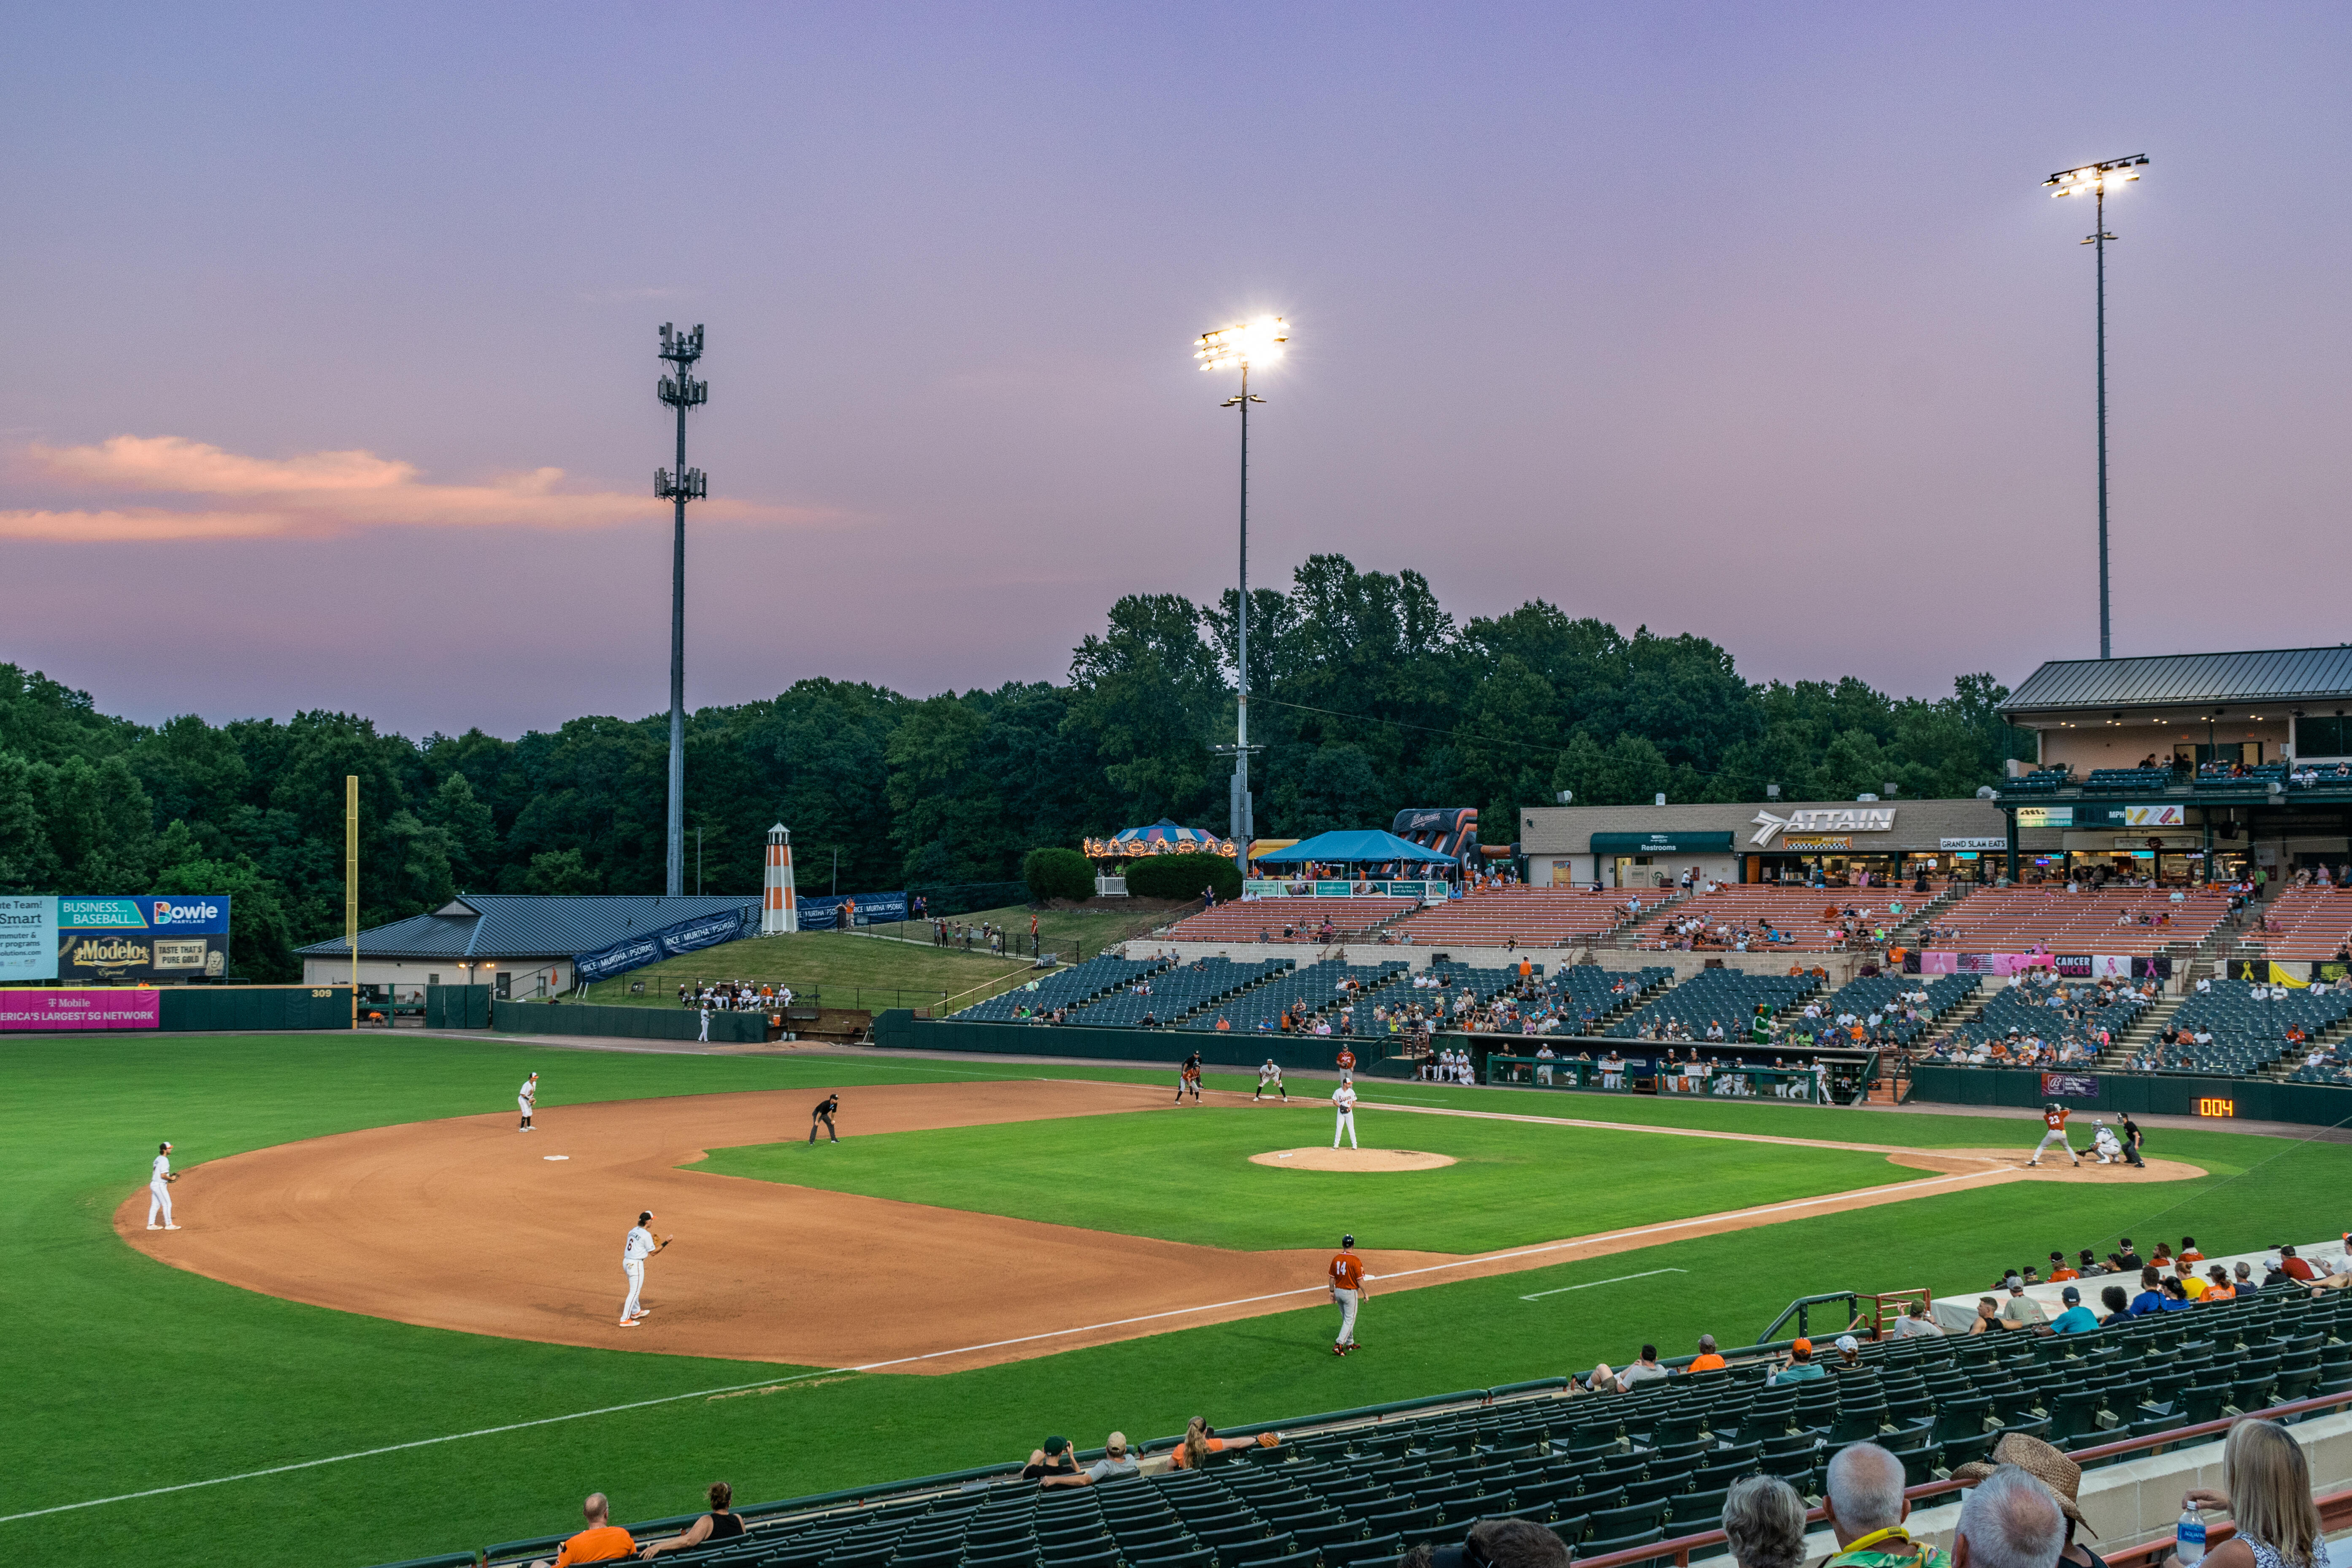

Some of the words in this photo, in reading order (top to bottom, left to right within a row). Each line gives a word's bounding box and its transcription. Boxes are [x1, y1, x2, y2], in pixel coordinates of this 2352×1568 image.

[1785, 810, 1893, 830] ATTAIN
[14, 901, 43, 909] Team!
[63, 902, 127, 912] BUSINESS...
[154, 901, 218, 924] Bowie
[805, 909, 824, 917] MURTHA
[0, 914, 42, 924] Smart
[73, 914, 140, 924] BASEBALL...
[666, 936, 680, 946] RICE
[684, 928, 710, 941] MURTHA
[713, 920, 735, 933] PSORAS
[83, 940, 141, 960] Modelo
[582, 962, 597, 972] RICE
[600, 952, 627, 967] MURTHA
[630, 944, 653, 957] PSORAS
[2055, 957, 2090, 966] CANCER
[311, 989, 332, 998] 309
[59, 999, 91, 1007] Mobile
[0, 1012, 39, 1021] ERICA'S
[42, 1012, 86, 1021] LARGEST
[87, 1012, 101, 1020] 5G
[103, 1011, 154, 1020] NETWORK
[2201, 1098, 2233, 1117] 004
[2049, 1115, 2060, 1125] 23
[627, 1238, 633, 1251] 6
[1336, 1261, 1346, 1275] 14
